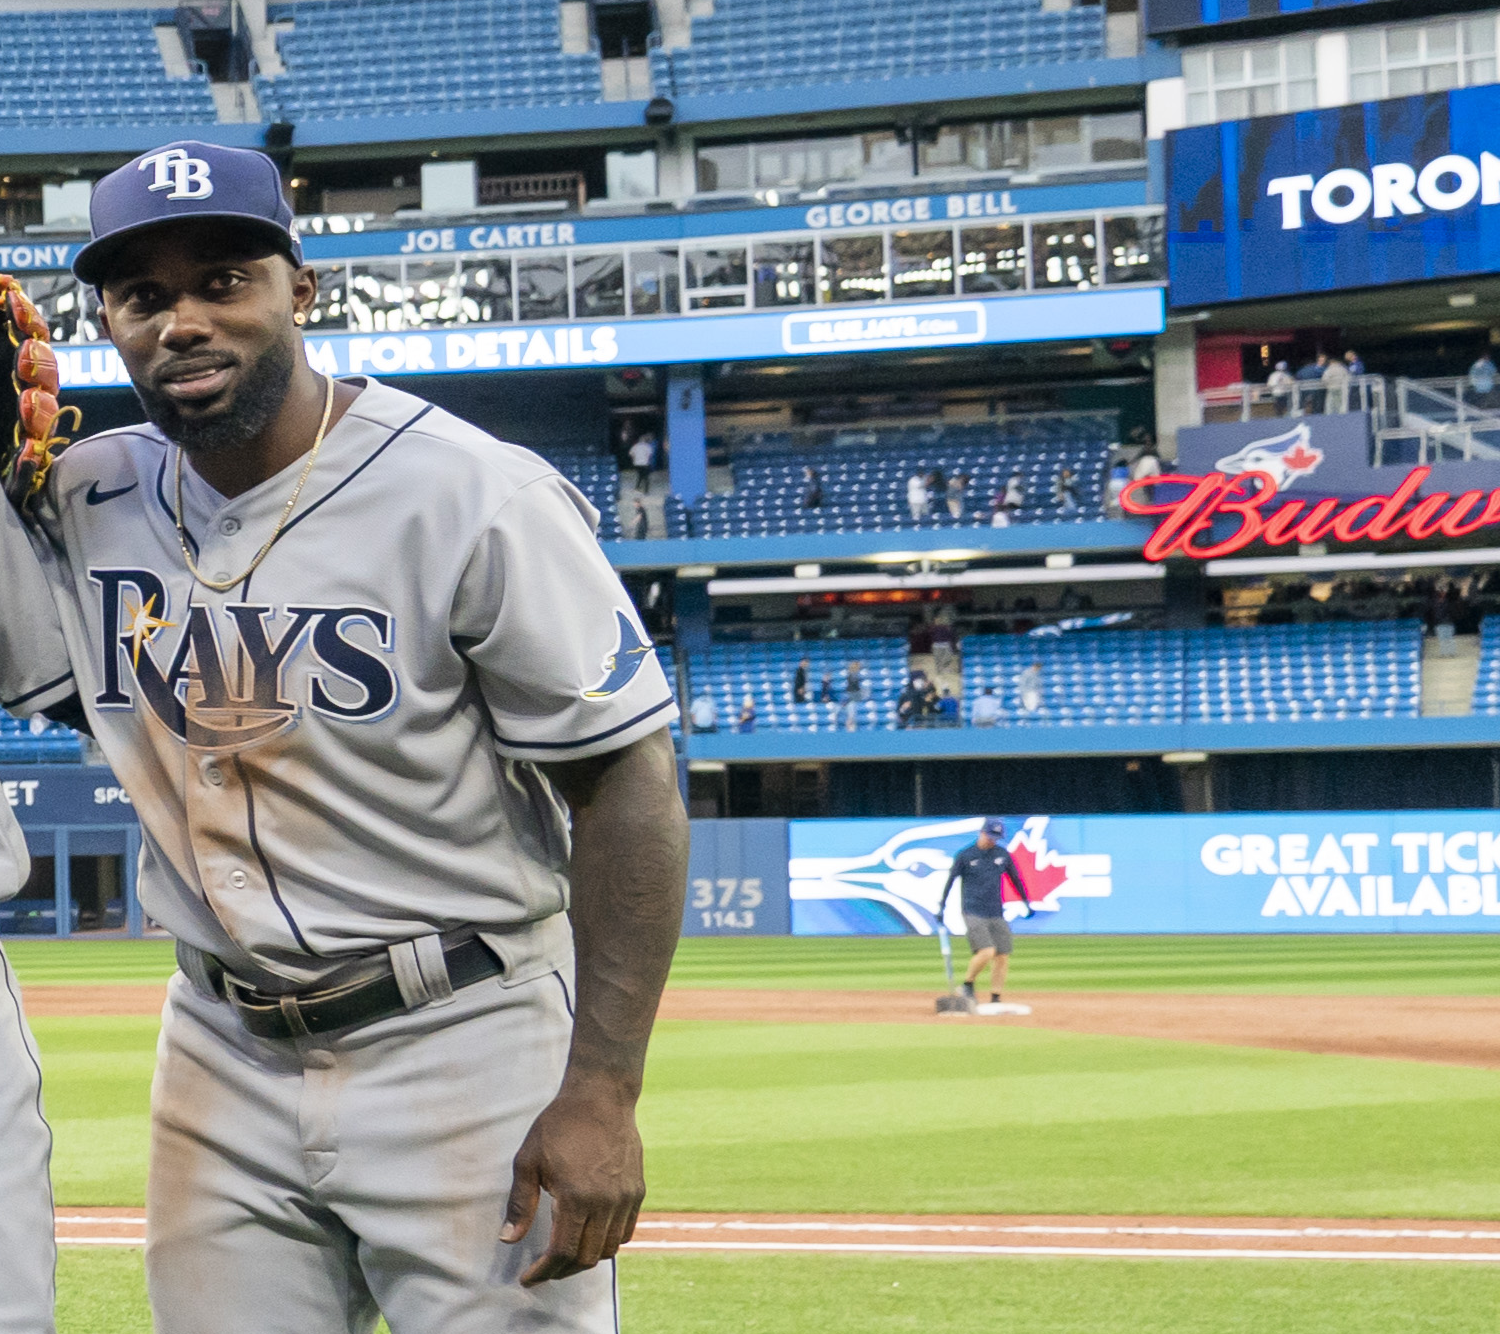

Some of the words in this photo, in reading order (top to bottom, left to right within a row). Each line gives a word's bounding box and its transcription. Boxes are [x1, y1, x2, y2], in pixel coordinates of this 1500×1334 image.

[138, 148, 214, 201] TB
[806, 196, 931, 230] GEORGE
[946, 190, 1018, 217] BELL
[402, 227, 461, 253] JOE
[468, 223, 576, 249] CARTER
[349, 337, 434, 372] FOR
[456, 326, 618, 368] DETAILS
[1119, 466, 1500, 561] Budw
[87, 566, 399, 751] RAYS
[1200, 833, 1378, 875] GREAT
[692, 878, 764, 908] 375
[701, 911, 754, 928] 114.3
